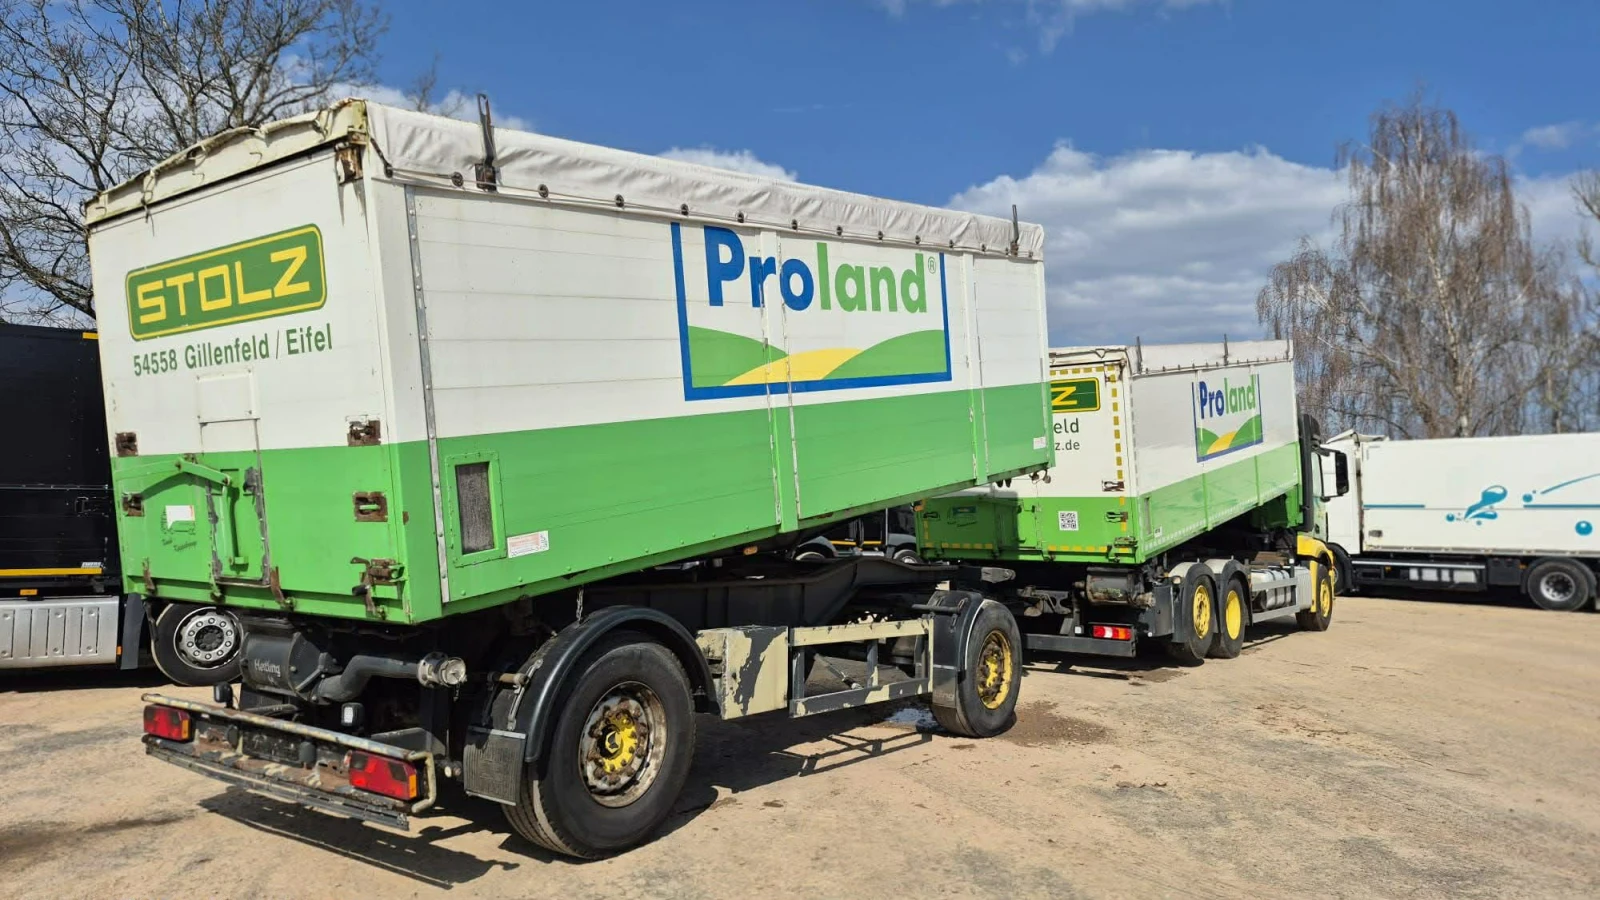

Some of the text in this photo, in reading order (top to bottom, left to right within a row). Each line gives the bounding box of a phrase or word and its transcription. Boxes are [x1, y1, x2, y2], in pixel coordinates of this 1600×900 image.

[137, 245, 311, 324] STOLZ
[133, 350, 178, 377] 54558
[185, 333, 270, 370] Gillenfeld
[287, 323, 333, 356] Eifel
[1199, 374, 1256, 420] Proland
